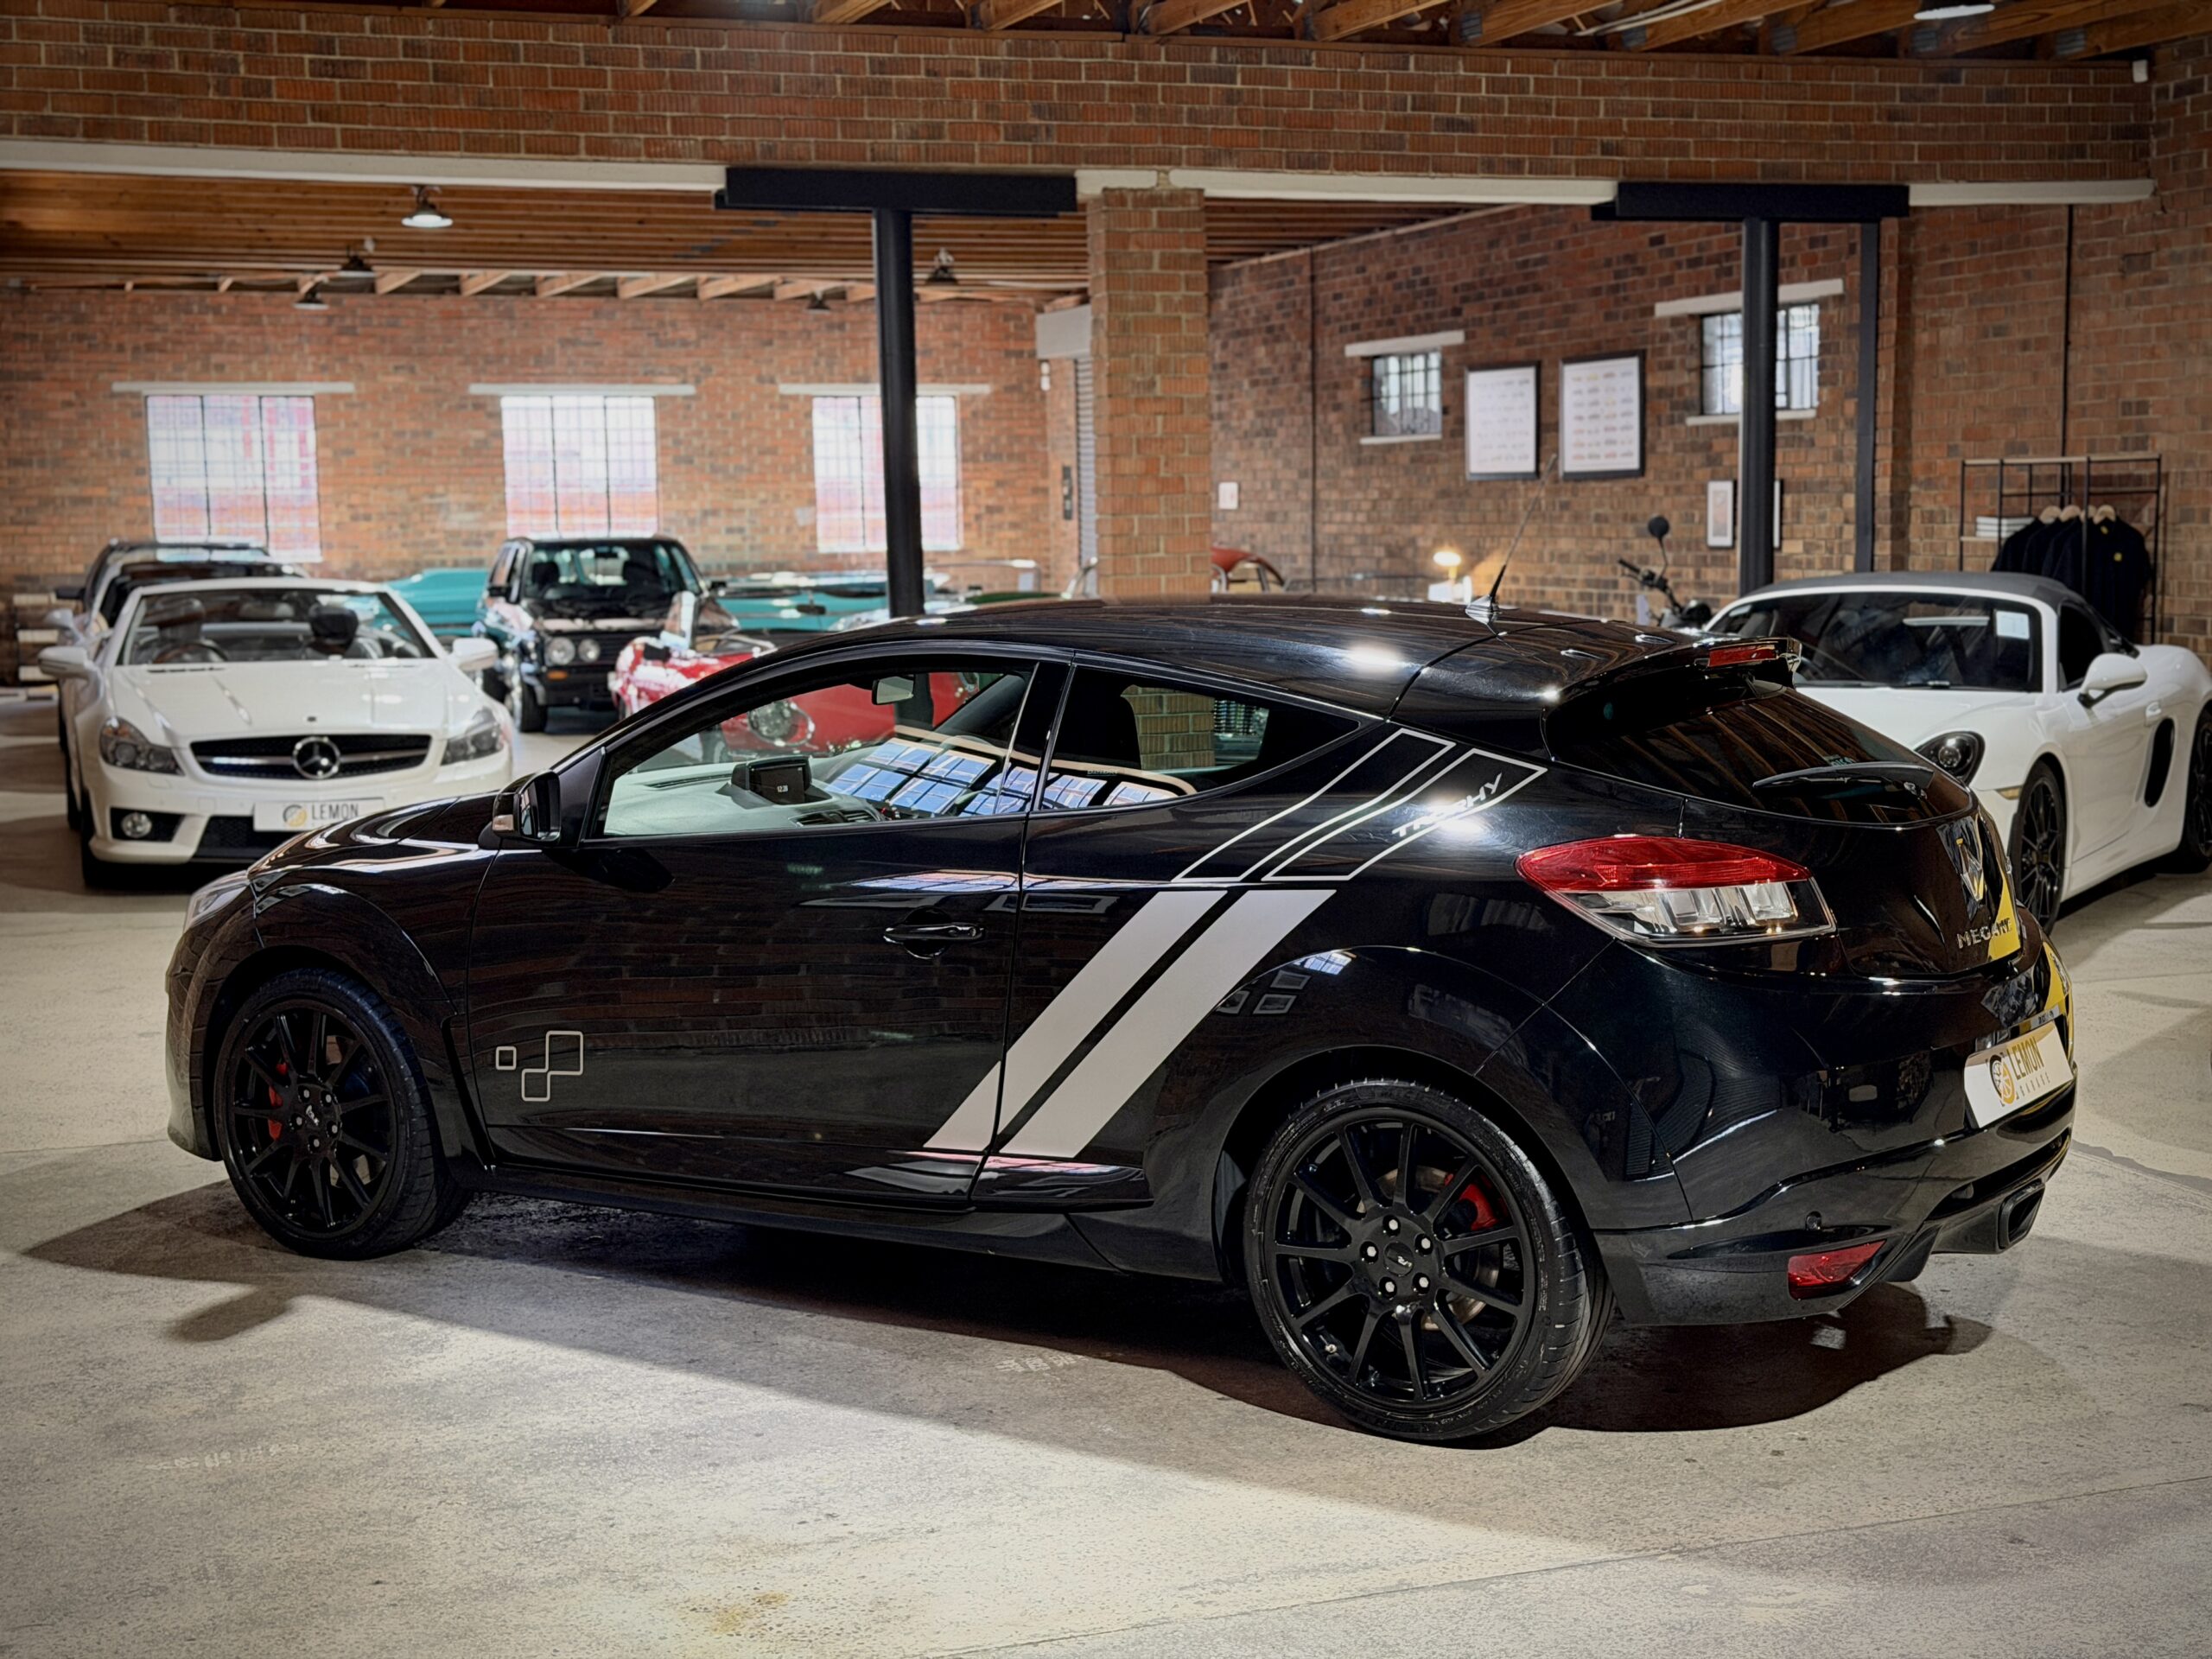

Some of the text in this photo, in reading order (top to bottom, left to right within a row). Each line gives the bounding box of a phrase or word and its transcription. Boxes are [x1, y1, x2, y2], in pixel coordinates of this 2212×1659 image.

[311, 803, 359, 821] LEMON
[1956, 918, 2012, 949] MEGANE
[2006, 1036, 2044, 1080] LEMON
